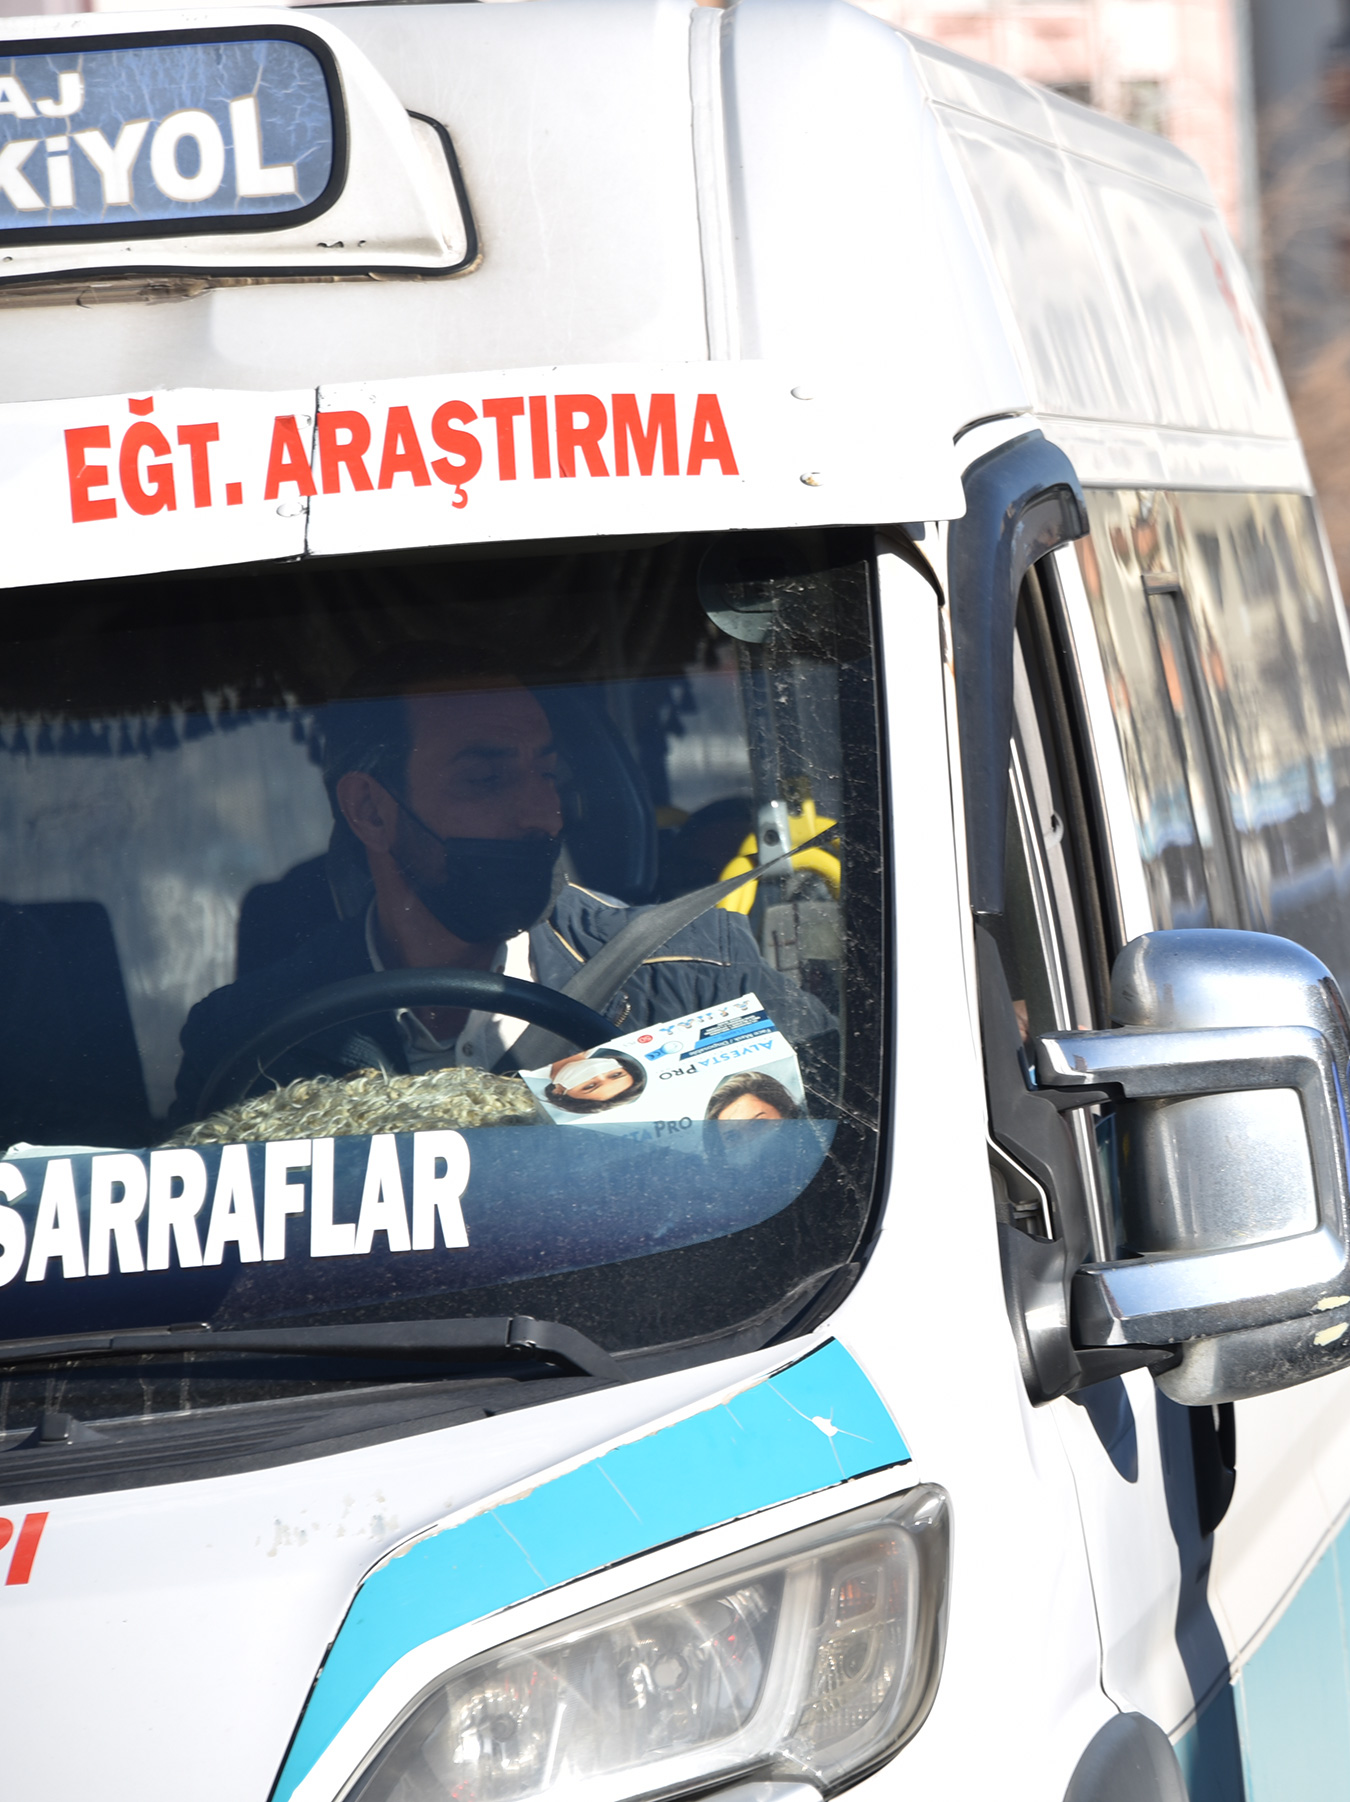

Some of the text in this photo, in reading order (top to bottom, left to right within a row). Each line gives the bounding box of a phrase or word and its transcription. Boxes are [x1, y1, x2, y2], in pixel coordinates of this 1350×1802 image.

[63, 393, 740, 524] EĞT. ARAŞTIRMA
[659, 1040, 773, 1080] ALVESTA PRO
[654, 1116, 692, 1138] PRO
